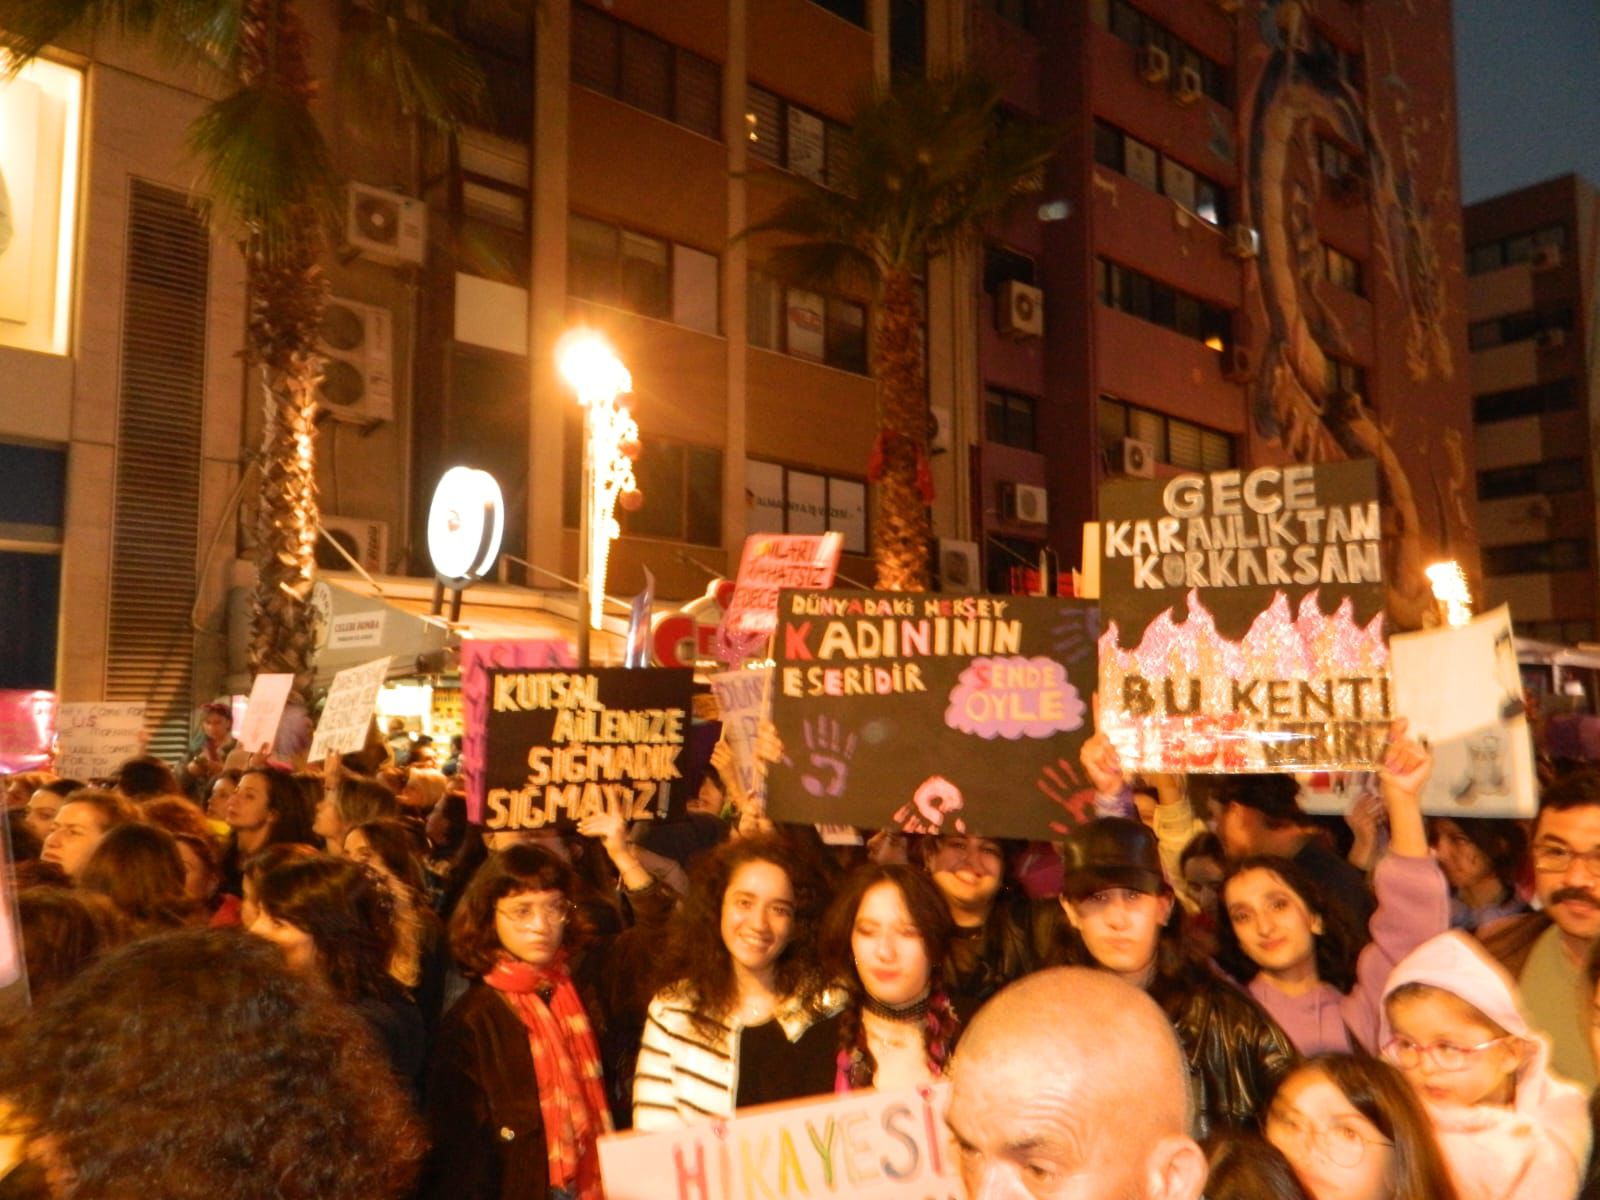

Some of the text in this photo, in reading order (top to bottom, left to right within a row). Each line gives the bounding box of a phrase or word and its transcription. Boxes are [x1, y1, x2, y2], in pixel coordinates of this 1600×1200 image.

[1163, 466, 1317, 518] GECE
[1105, 500, 1381, 558] KARANLIKTAN
[1133, 541, 1381, 589] KORKARSAN
[924, 596, 1009, 620] HERŞEY
[784, 617, 1022, 661] KADINININ
[493, 672, 605, 712] KUTSAL
[783, 663, 928, 697] ESERİDİR
[972, 664, 1058, 691] SENDE
[1121, 668, 1390, 718] BU KENTİ
[551, 707, 685, 743] AİLENİZE
[527, 742, 684, 785] SIĞMADIK
